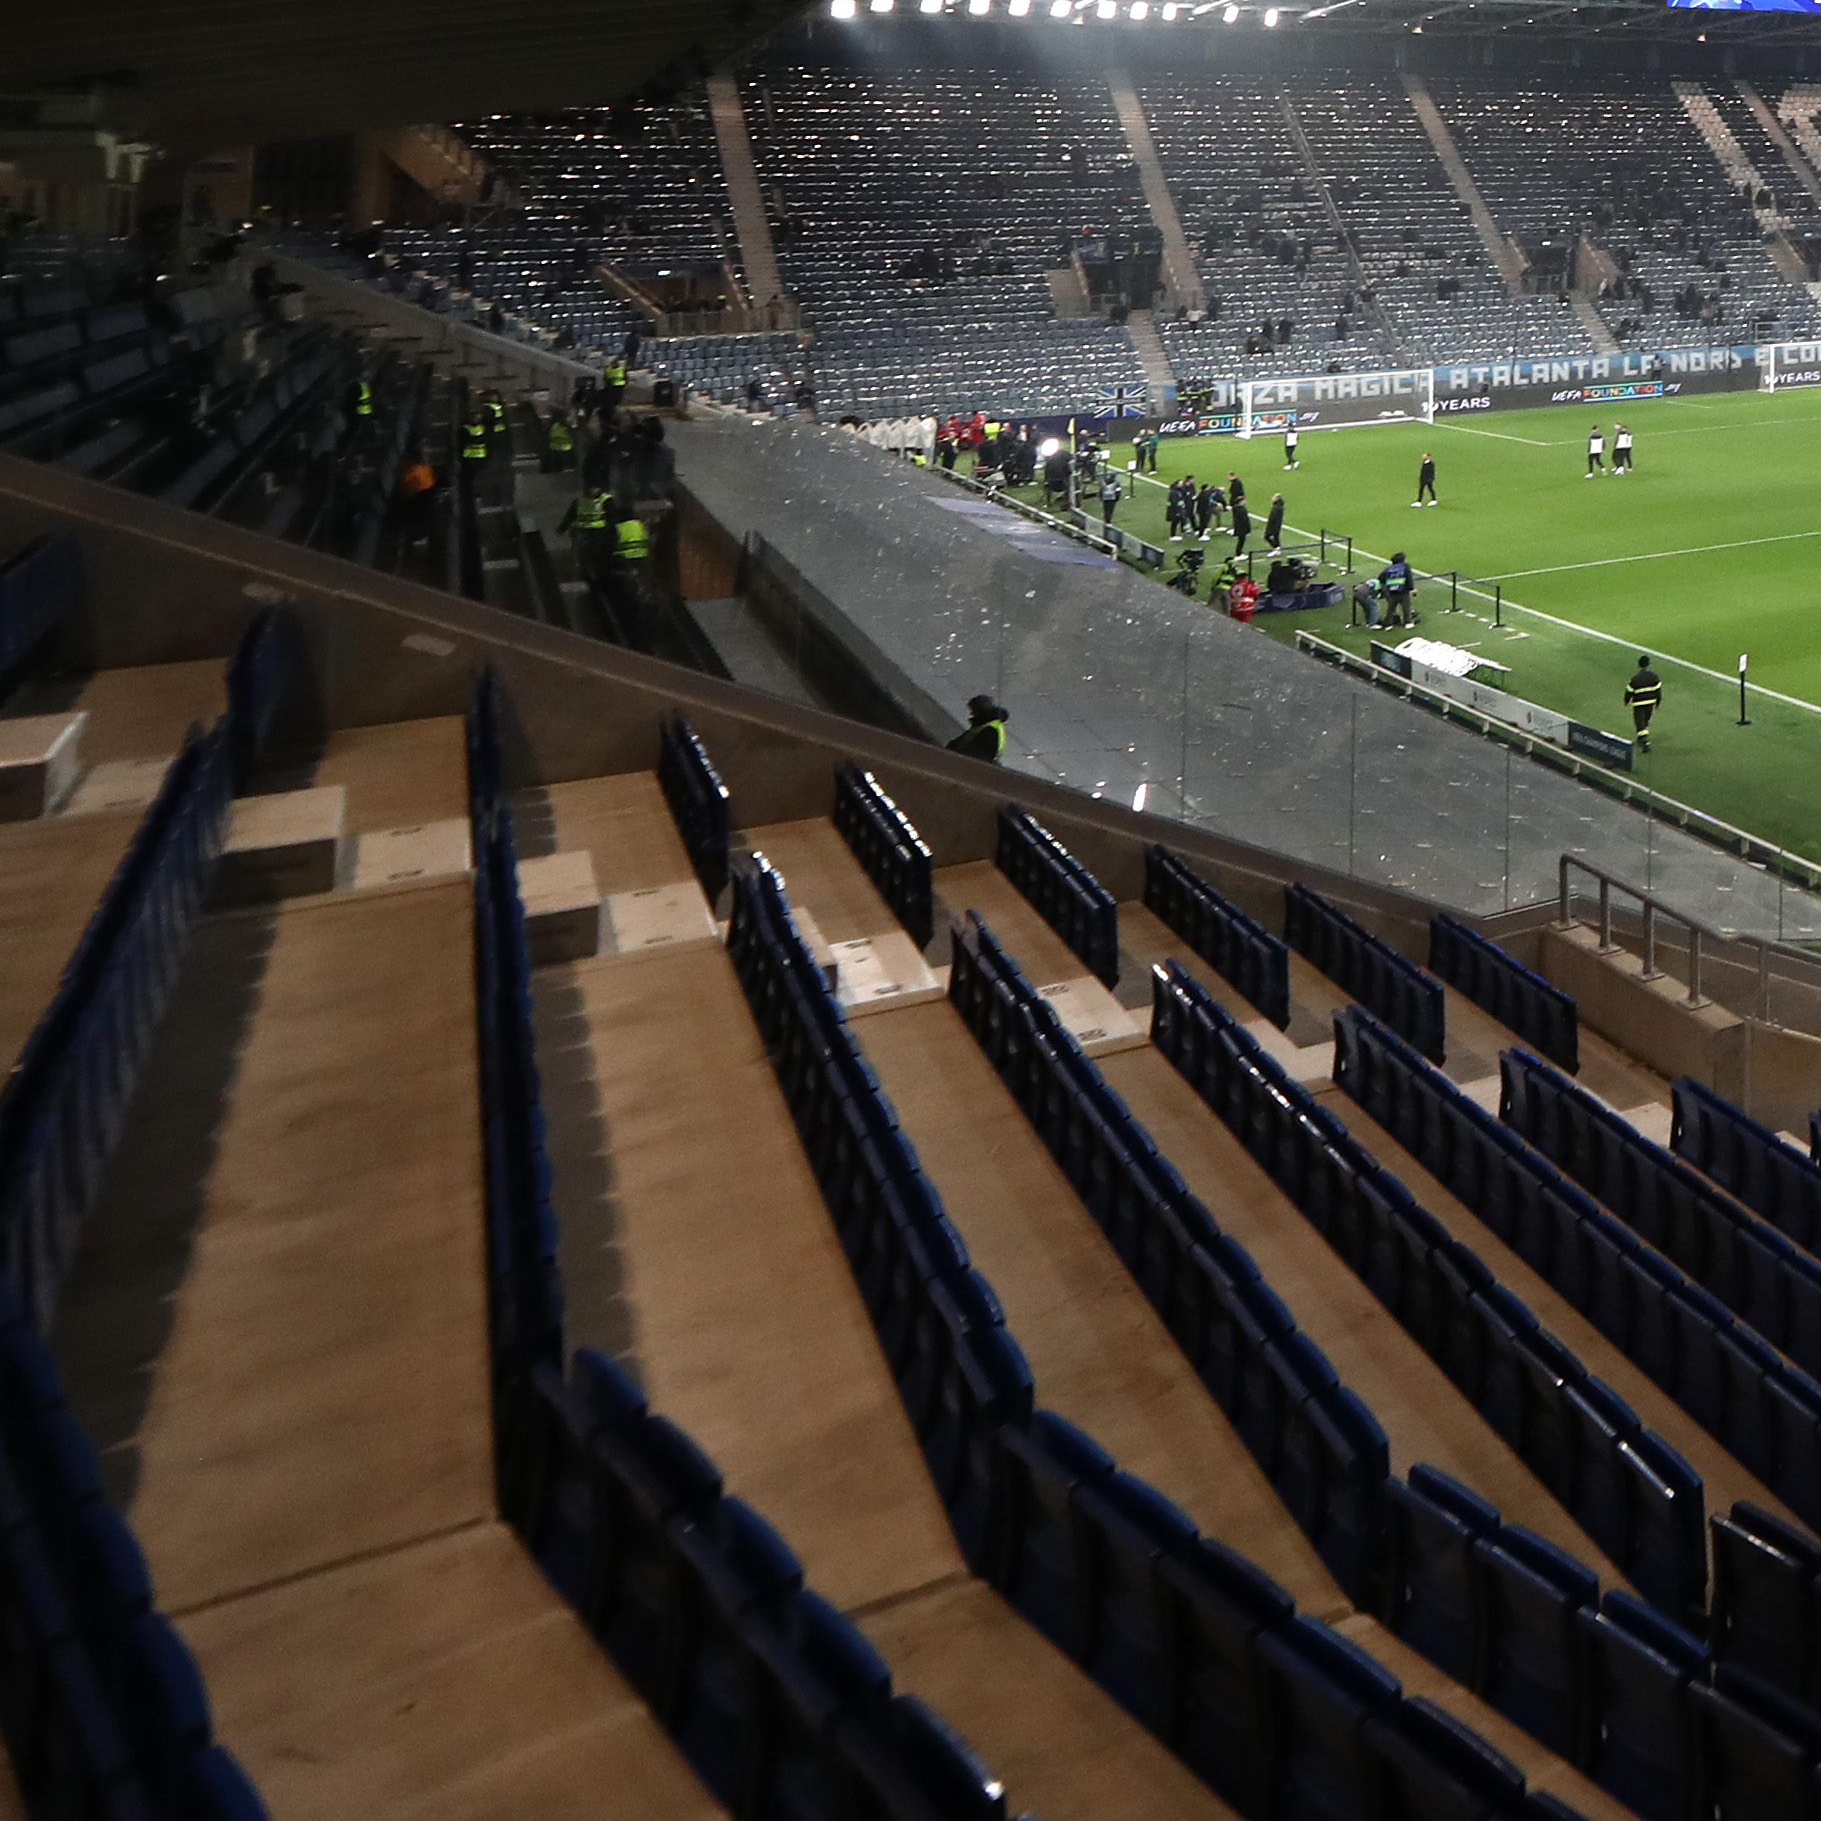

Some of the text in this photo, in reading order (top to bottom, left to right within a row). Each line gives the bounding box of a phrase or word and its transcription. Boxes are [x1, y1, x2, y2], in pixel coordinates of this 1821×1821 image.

[1314, 371, 1430, 401] MAGICA
[1451, 358, 1611, 390] ATALANTA
[1552, 390, 1583, 402] UEFA
[1584, 384, 1663, 399] FOUNDATION
[1159, 420, 1198, 434] UEFA
[1198, 412, 1298, 429] FOUNATION
